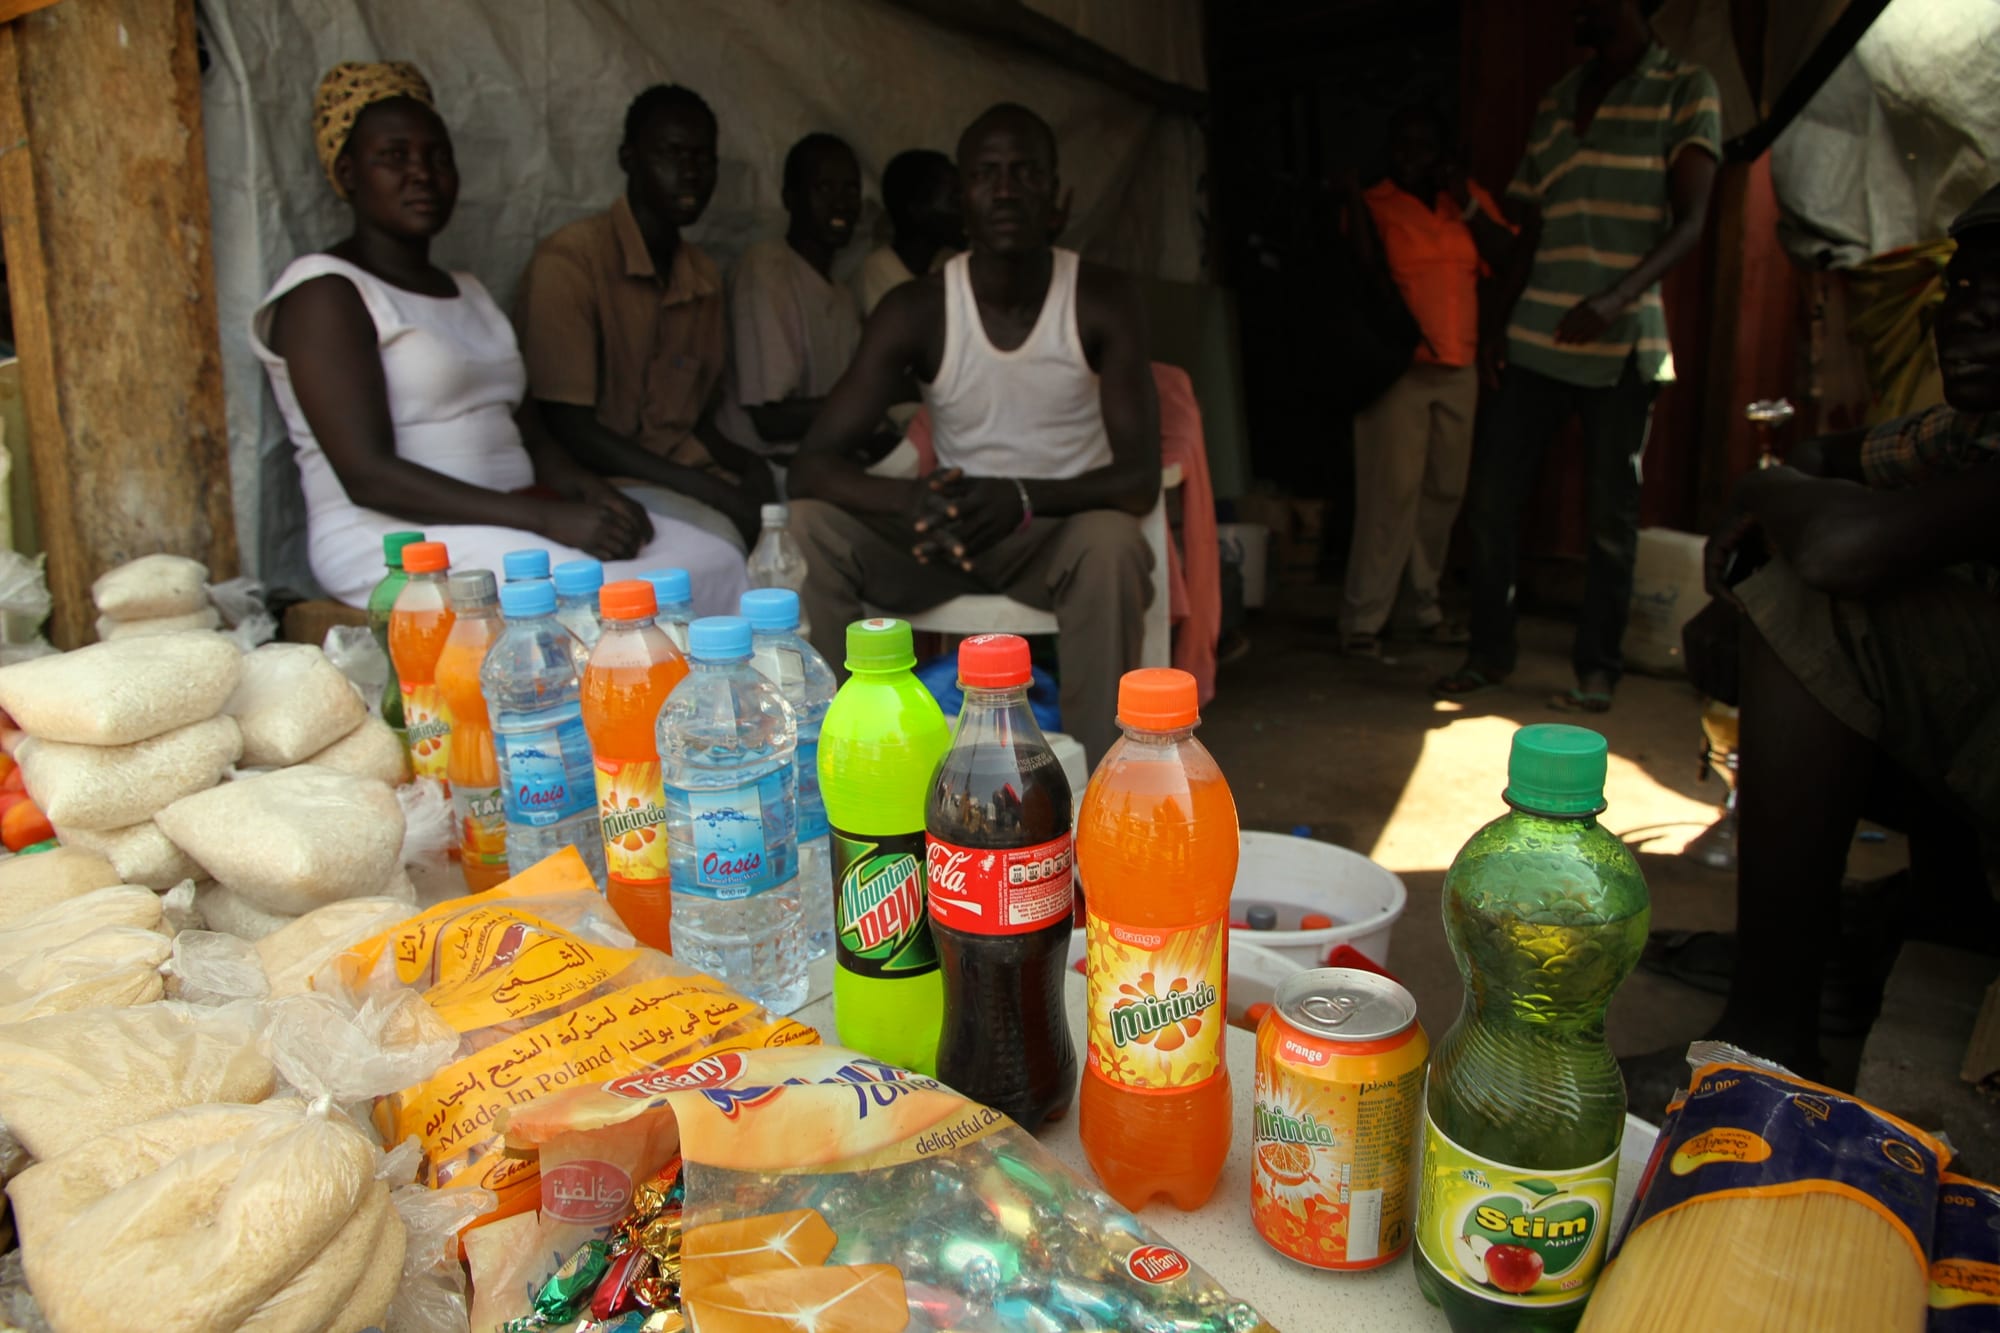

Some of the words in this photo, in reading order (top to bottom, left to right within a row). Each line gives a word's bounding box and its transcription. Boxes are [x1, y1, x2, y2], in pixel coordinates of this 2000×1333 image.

[519, 785, 564, 805] Oasis
[703, 852, 761, 875] Oasis
[844, 856, 918, 927] Mountain
[1114, 927, 1161, 946] Orange
[680, 1009, 700, 1036] في
[703, 1001, 739, 1026] صنع
[619, 1026, 675, 1055] بولندا
[1286, 1040, 1323, 1062] orange
[619, 1056, 727, 1096] Tiffany
[438, 1103, 502, 1152] Made
[505, 1084, 536, 1105] In
[535, 1044, 615, 1094] Poland
[916, 1114, 984, 1156] delightful
[1475, 1206, 1588, 1239] Stim
[1545, 1235, 1585, 1248] Apple
[1133, 1252, 1184, 1279] Tiffany
